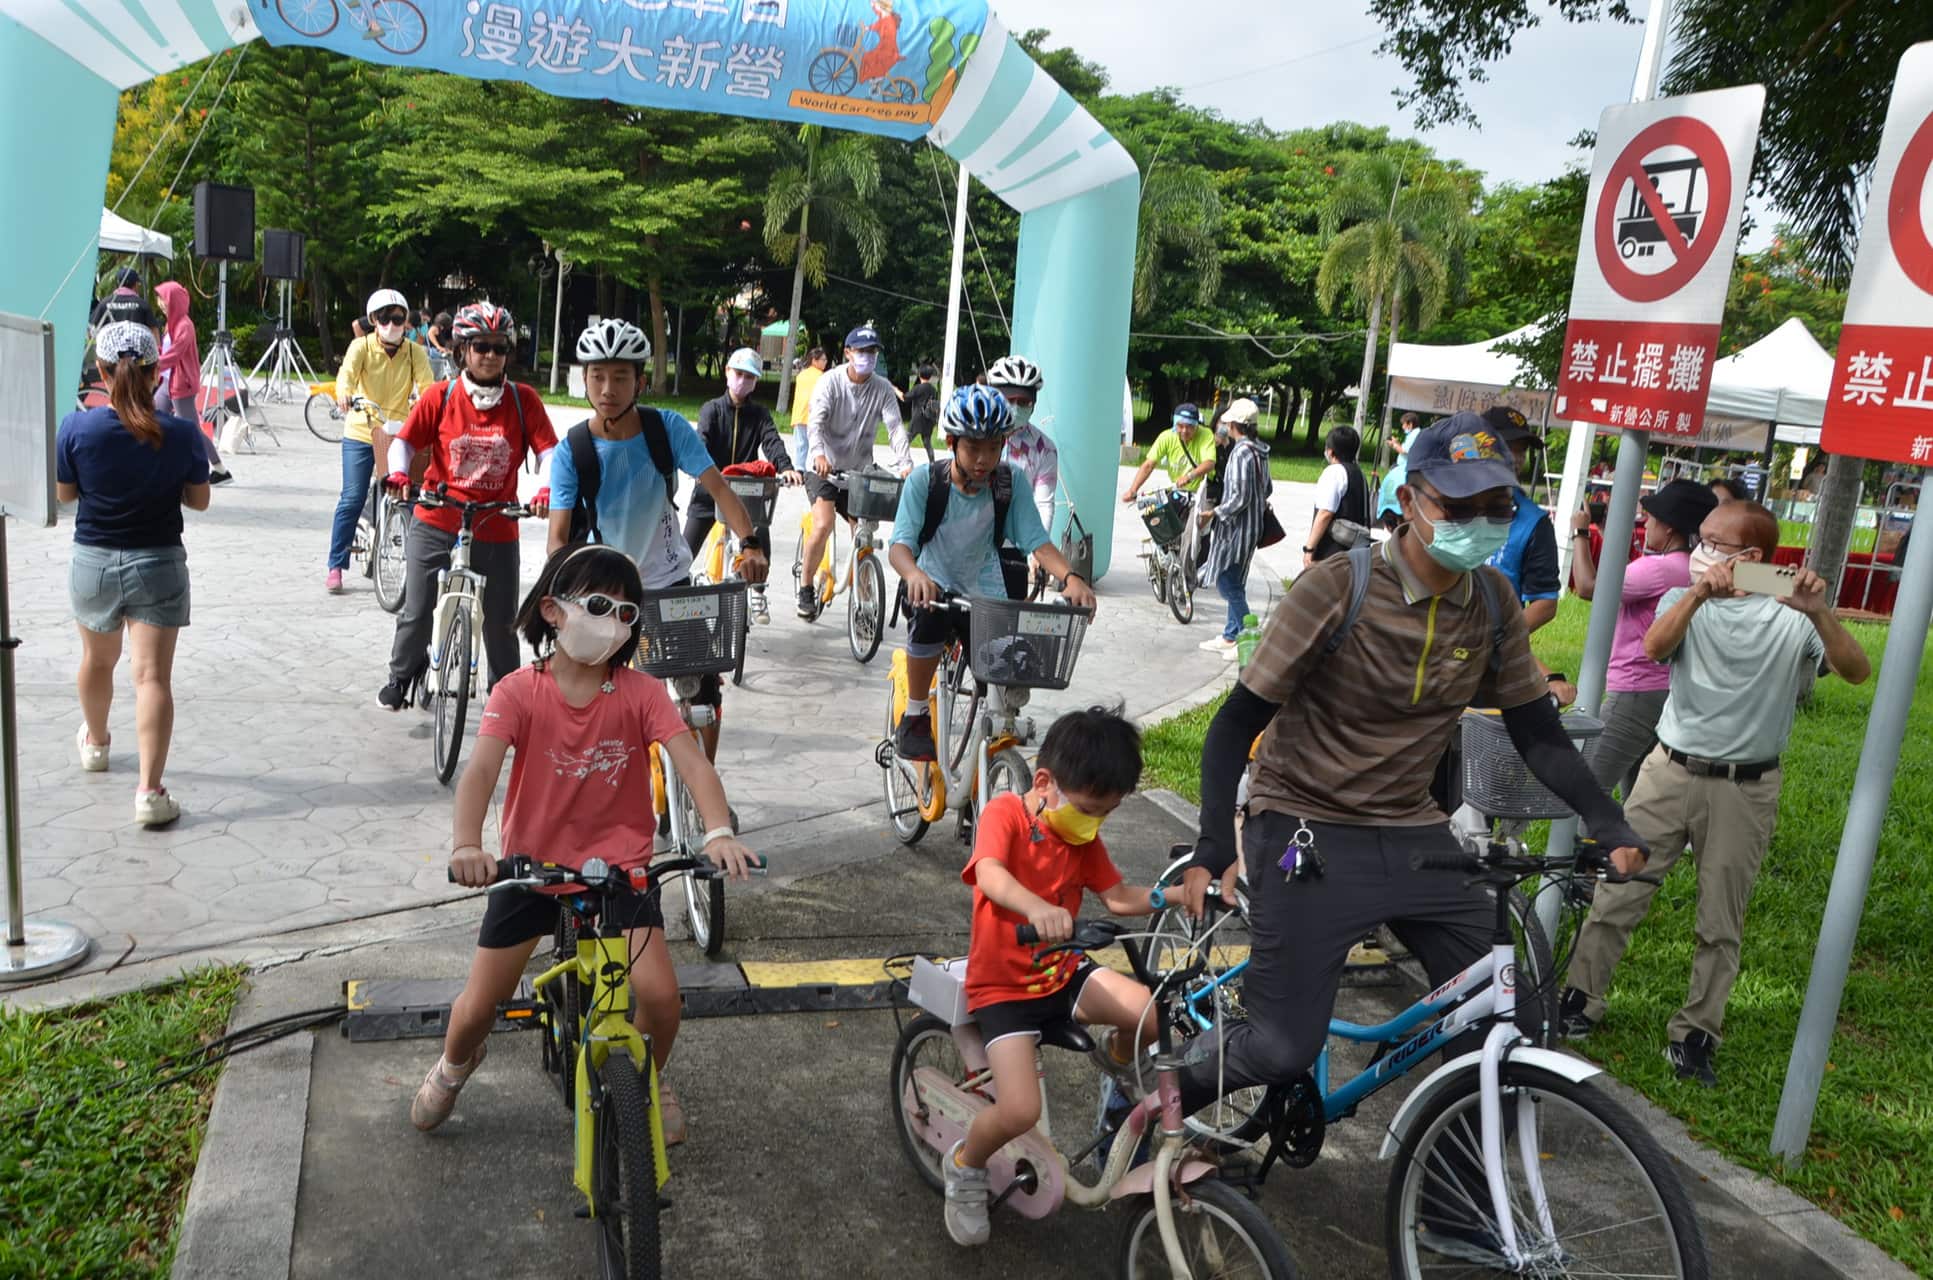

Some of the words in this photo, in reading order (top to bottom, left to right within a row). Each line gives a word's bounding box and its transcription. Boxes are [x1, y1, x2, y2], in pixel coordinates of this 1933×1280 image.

[460, 0, 787, 99] 漫遊大新營
[800, 96, 837, 111] World
[840, 101, 861, 113] Car
[1568, 338, 1706, 393] 禁止擺攤
[1843, 350, 1933, 409] 禁止
[1609, 403, 1670, 430] 新營公所
[1910, 435, 1933, 461] 新
